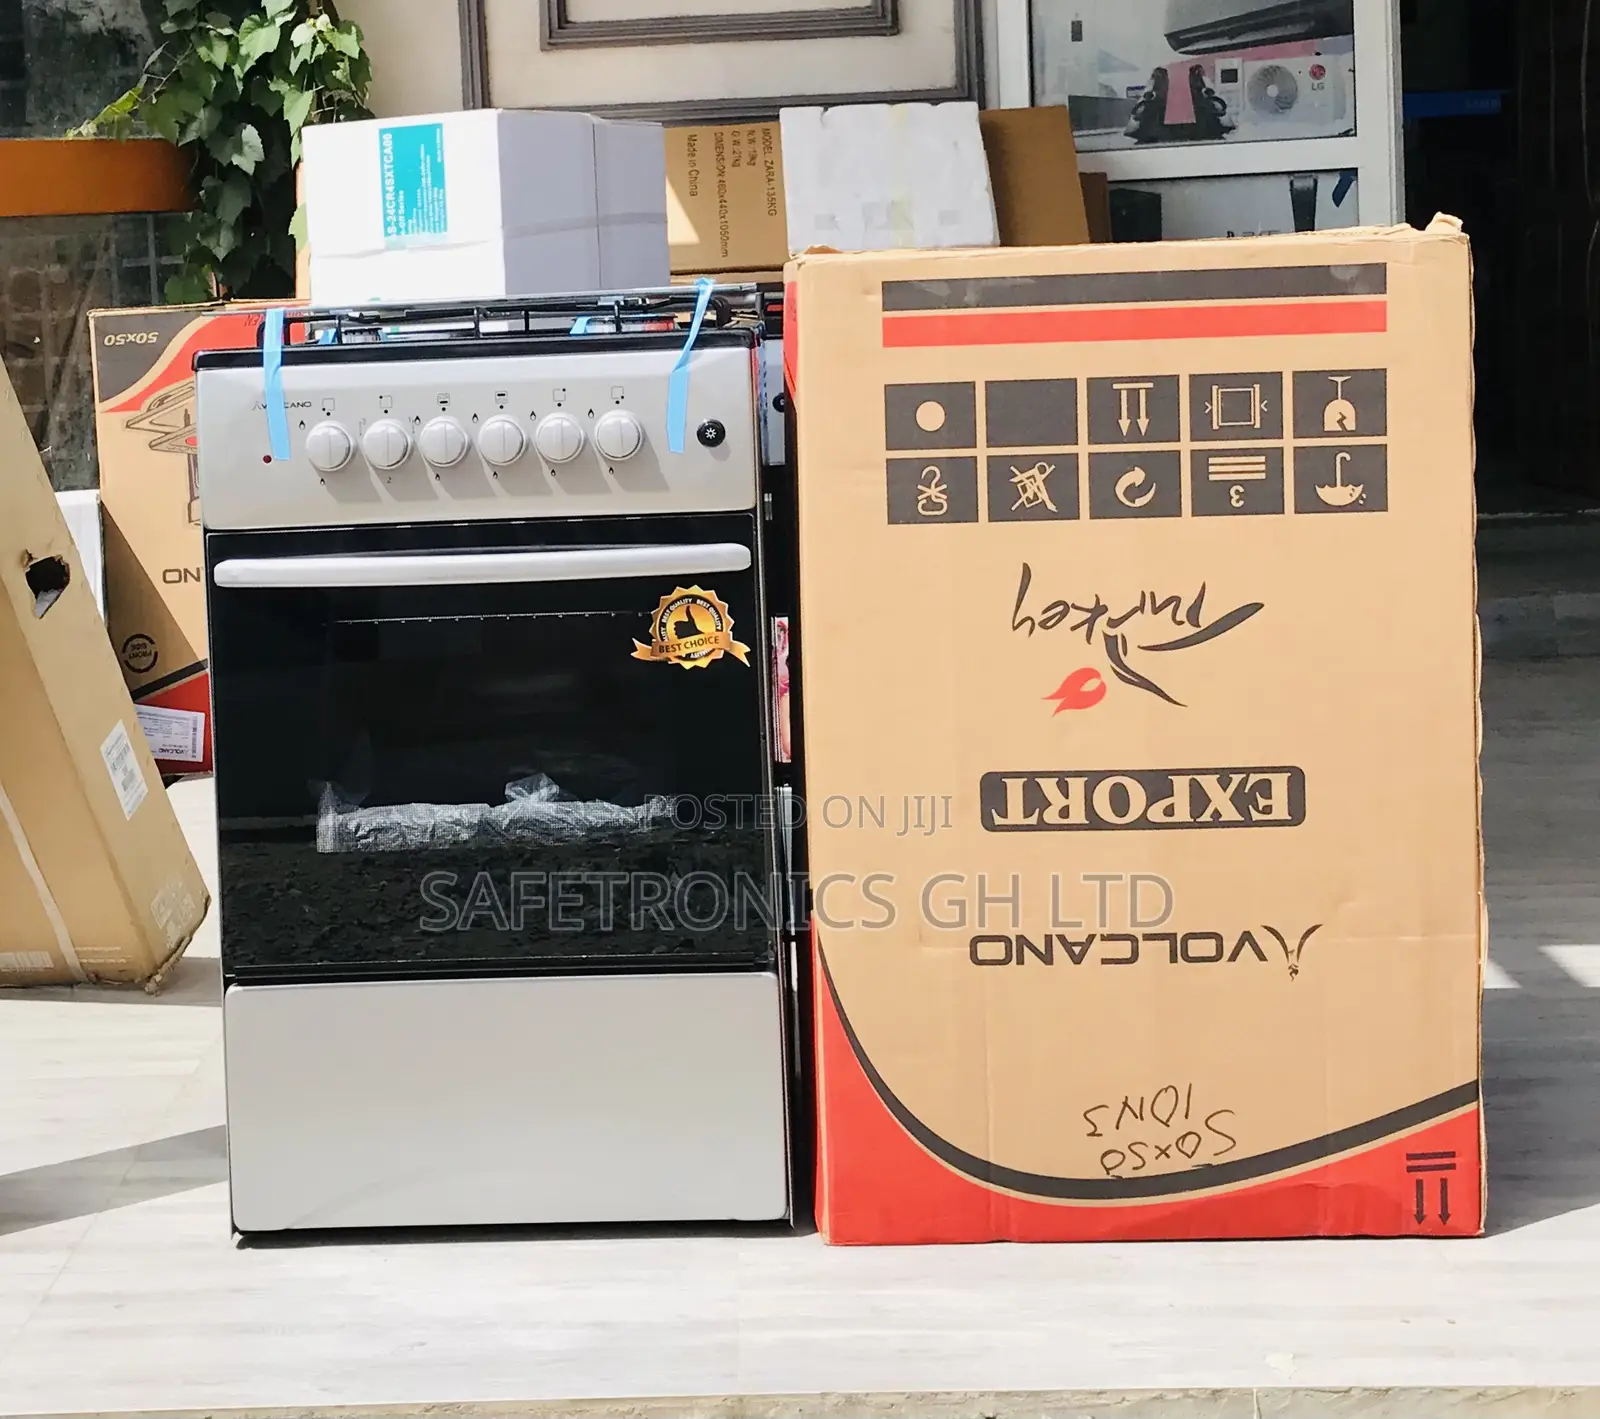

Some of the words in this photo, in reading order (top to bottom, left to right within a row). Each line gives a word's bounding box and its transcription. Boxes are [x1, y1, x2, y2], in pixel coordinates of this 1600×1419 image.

[1311, 82, 1325, 91] LG
[687, 134, 698, 158] Made
[688, 159, 697, 168] in
[689, 169, 700, 197] China
[104, 331, 159, 346] 50x50
[696, 598, 710, 609] BEST
[1012, 562, 1265, 652] Turkey
[658, 643, 682, 653] BEST
[683, 635, 720, 650] CHOICE
[991, 772, 1292, 826] EXPORT
[969, 930, 1269, 966] VOLCANO
